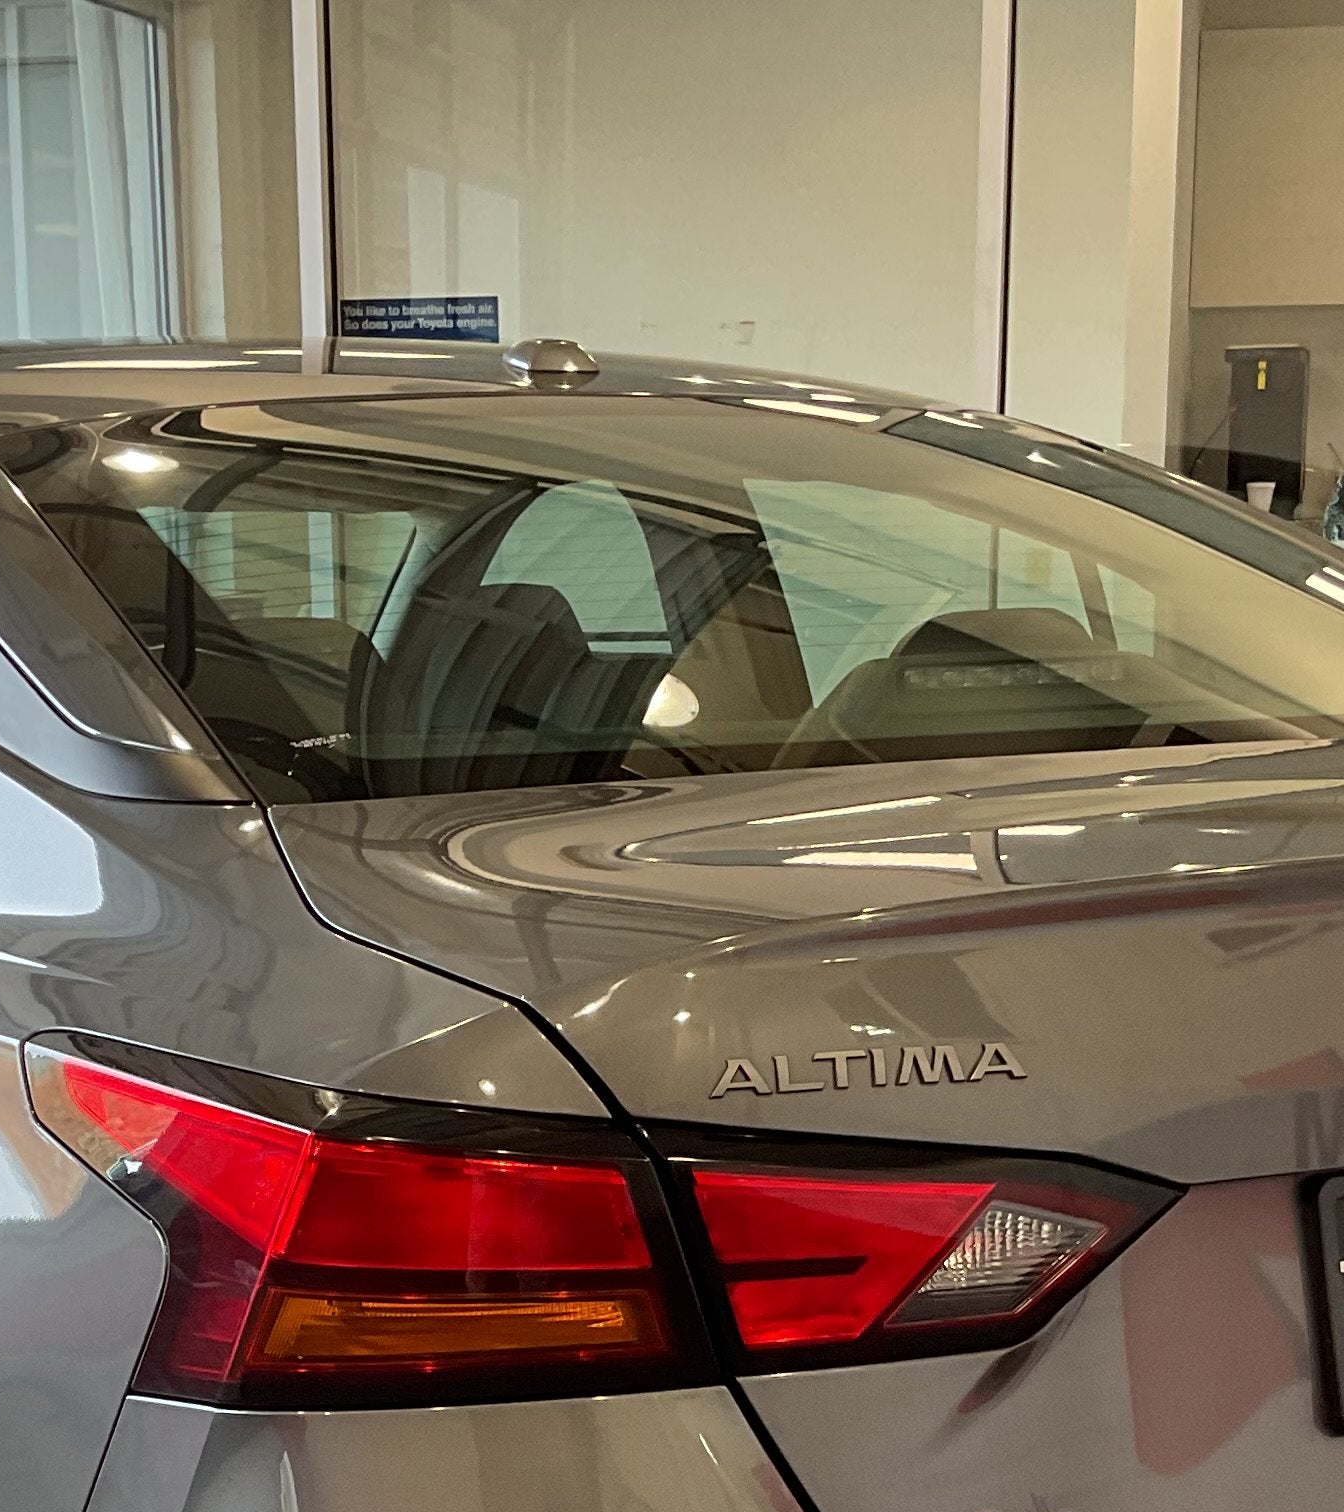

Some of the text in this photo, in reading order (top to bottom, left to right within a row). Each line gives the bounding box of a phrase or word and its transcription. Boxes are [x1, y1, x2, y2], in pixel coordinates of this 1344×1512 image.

[343, 305, 363, 317] You
[365, 304, 386, 316] like
[388, 304, 401, 316] to
[402, 303, 445, 316] breathe
[447, 302, 476, 315] fresh
[361, 318, 388, 330] does
[391, 318, 416, 332] your
[417, 316, 454, 331] Toyota
[709, 1041, 1028, 1099] ALTIMA
